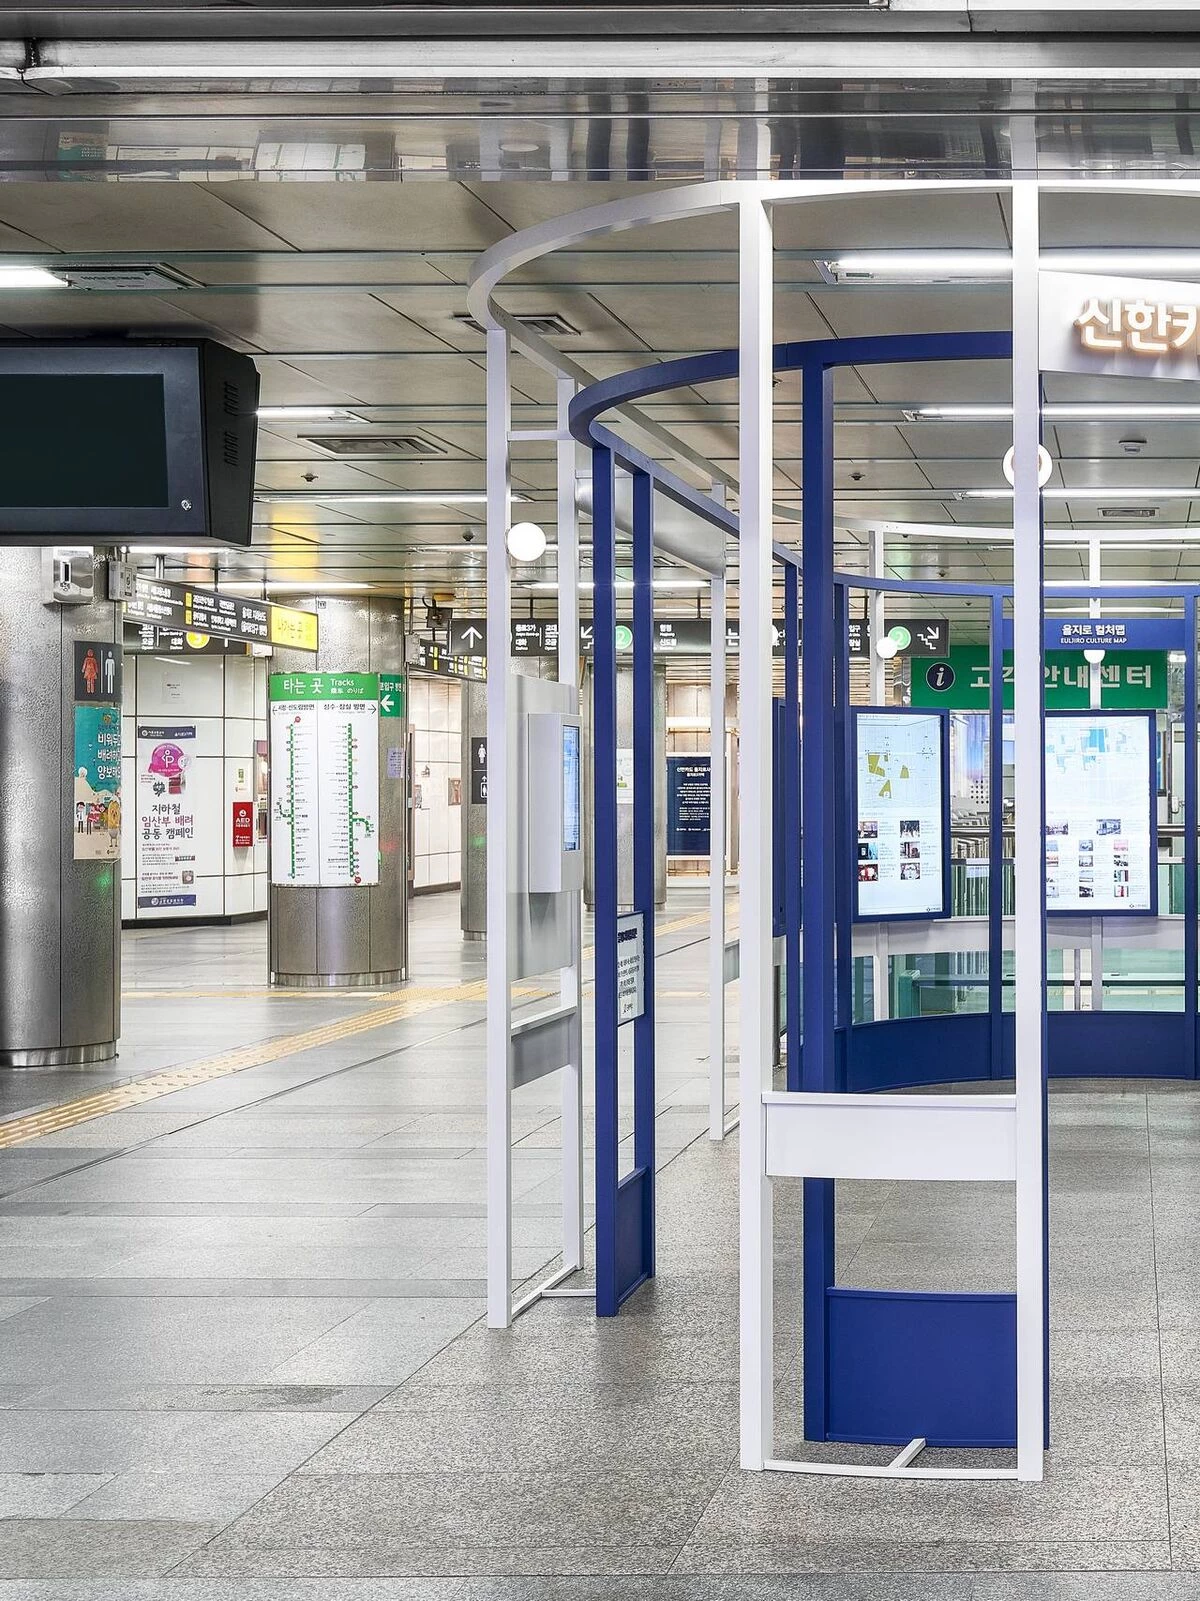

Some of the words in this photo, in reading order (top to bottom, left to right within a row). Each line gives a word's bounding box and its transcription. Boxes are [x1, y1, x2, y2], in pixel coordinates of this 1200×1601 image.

[1061, 624, 1092, 636] 을지로
[1095, 624, 1125, 636] 컬처맵
[283, 678, 306, 694] 타는
[310, 678, 324, 694] 곳
[331, 678, 355, 686] Tracks
[152, 803, 181, 815] 지하철
[142, 816, 171, 828] 임산부
[175, 815, 194, 826] 배려
[142, 828, 162, 840] 공동
[166, 827, 194, 839] 캠페인
